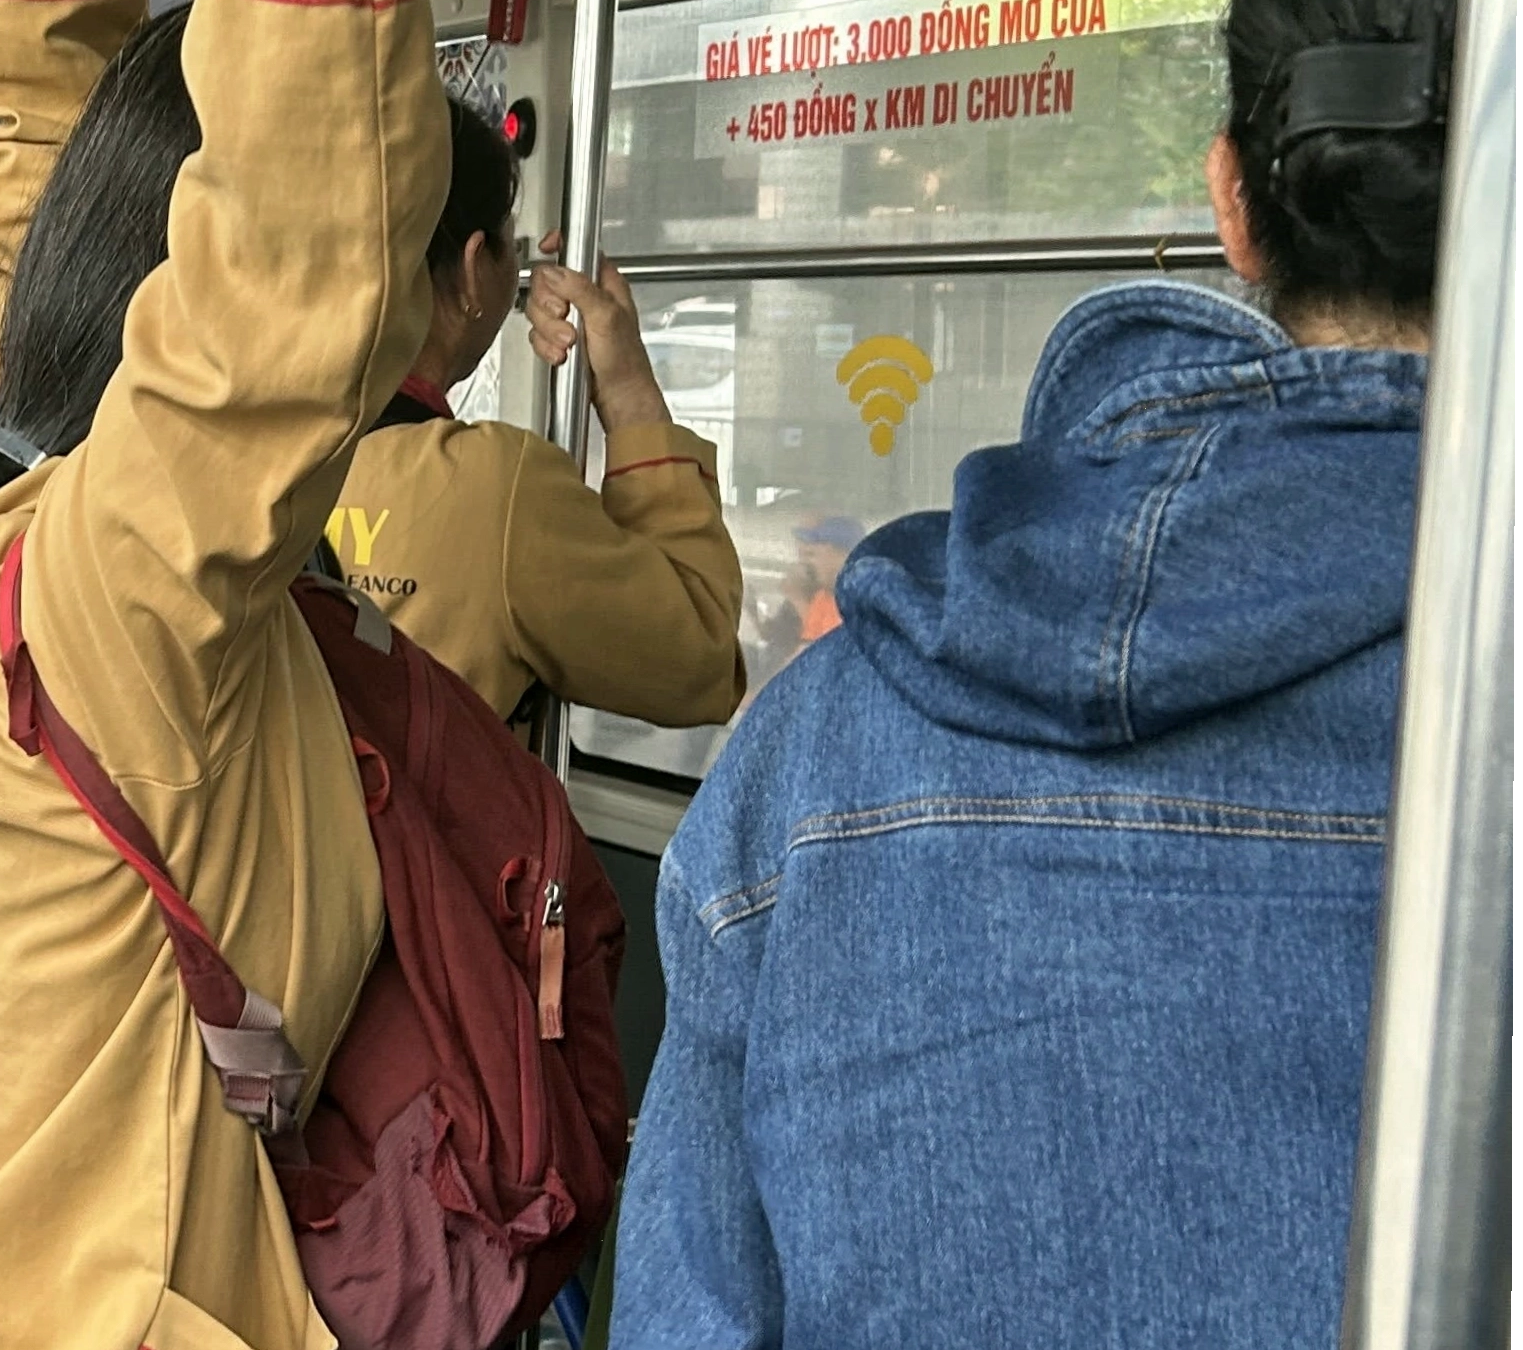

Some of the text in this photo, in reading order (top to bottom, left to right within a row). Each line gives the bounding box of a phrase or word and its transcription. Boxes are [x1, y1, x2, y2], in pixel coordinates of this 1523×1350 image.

[706, 32, 739, 81] GIÁ
[748, 32, 772, 75] VÉ
[780, 23, 838, 78] LƯỢT:
[847, 15, 912, 61] 3.000
[726, 117, 740, 141] +
[747, 102, 786, 142] 450
[793, 82, 855, 138] ĐỒNG
[885, 85, 924, 130] KM
[933, 83, 958, 125] DI
[967, 52, 1074, 121] CHUYỂN
